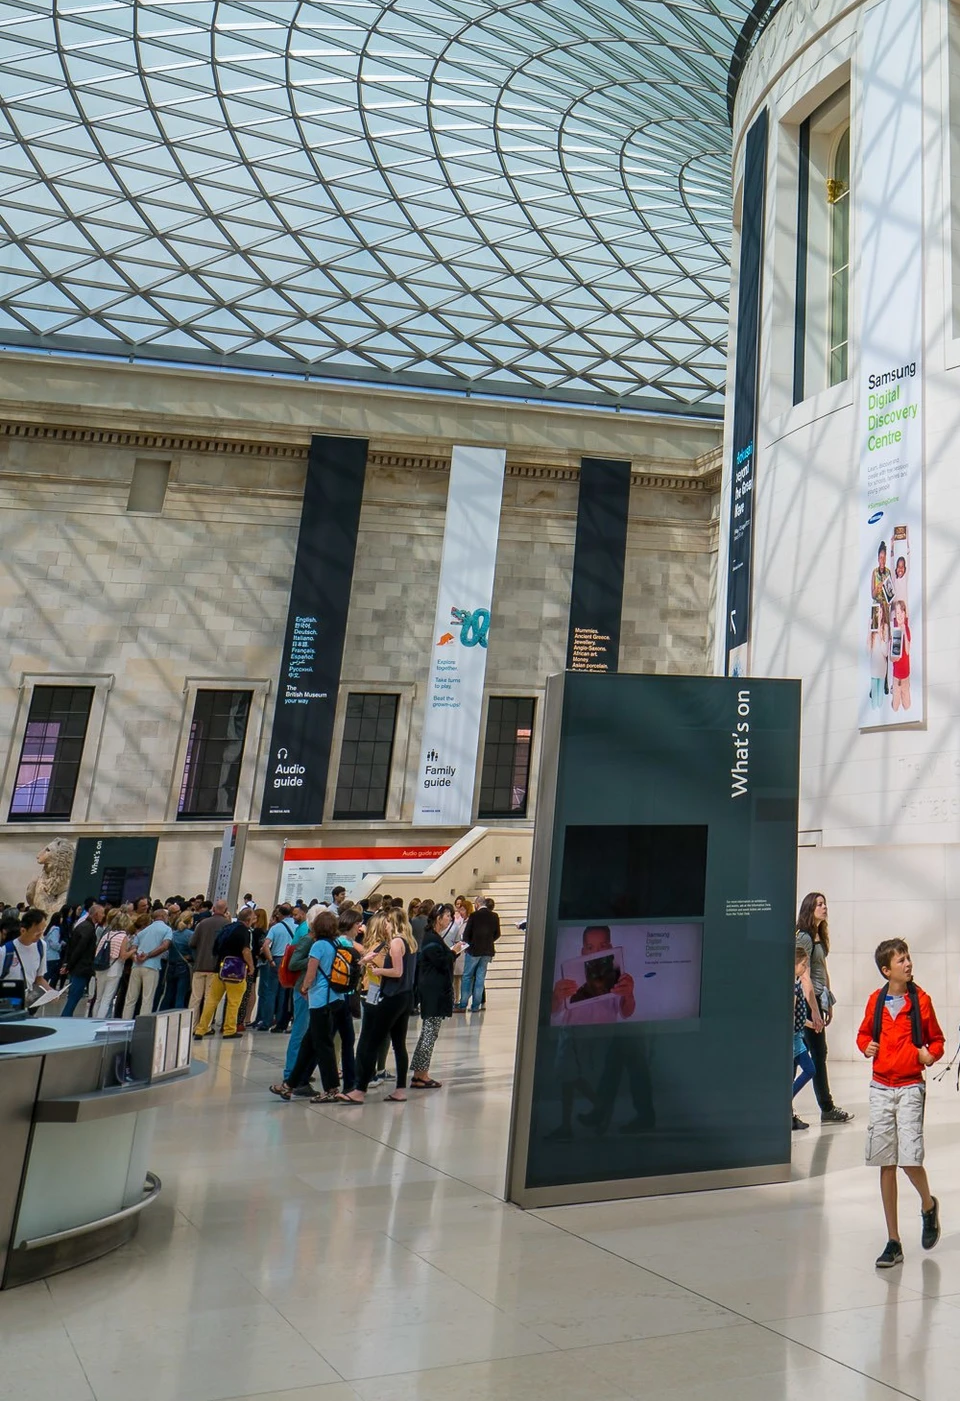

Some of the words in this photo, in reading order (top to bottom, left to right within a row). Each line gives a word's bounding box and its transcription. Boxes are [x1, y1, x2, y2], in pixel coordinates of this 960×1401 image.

[868, 361, 916, 390] Samsung
[868, 384, 900, 411] Digital
[868, 403, 918, 432] Discovery
[867, 429, 902, 452] Centre
[737, 689, 751, 716] on
[275, 763, 306, 774] Audio
[425, 765, 457, 777] Family
[731, 722, 750, 798] What's
[273, 776, 303, 788] guide
[424, 778, 452, 788] guide
[90, 850, 101, 875] What's
[96, 840, 103, 850] on
